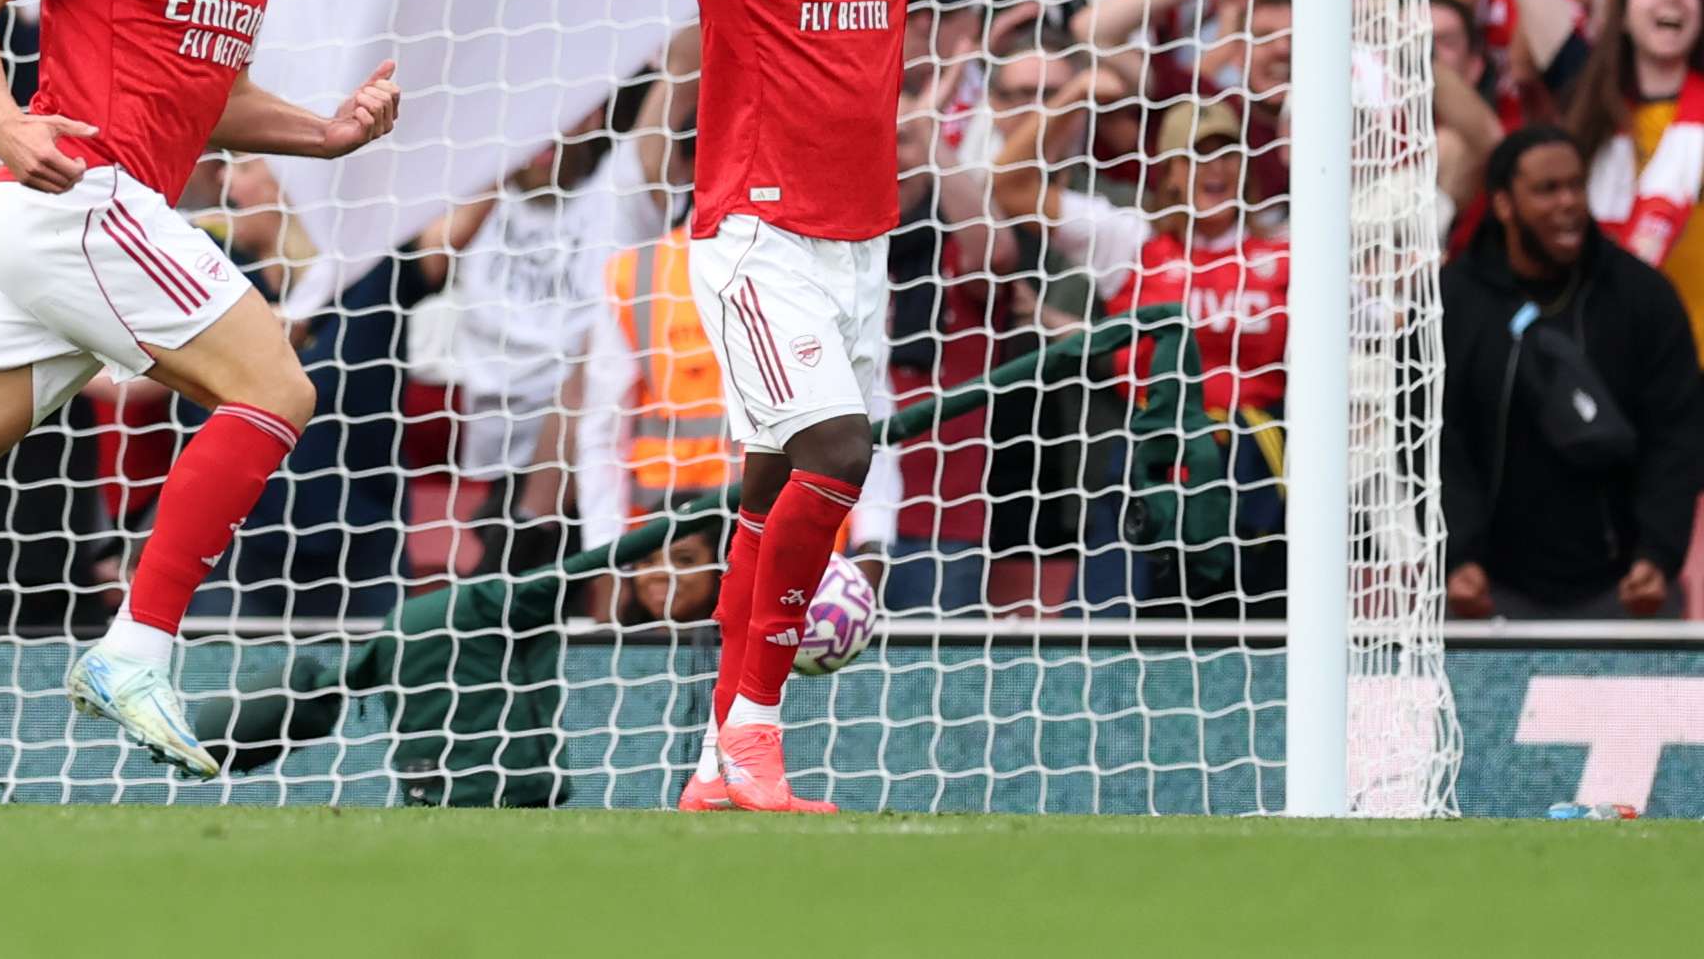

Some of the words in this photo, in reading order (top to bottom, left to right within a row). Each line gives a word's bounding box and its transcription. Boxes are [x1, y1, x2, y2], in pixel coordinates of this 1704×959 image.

[800, 1, 832, 31] FLY
[837, 0, 889, 31] BETTER
[178, 28, 213, 60] FLY
